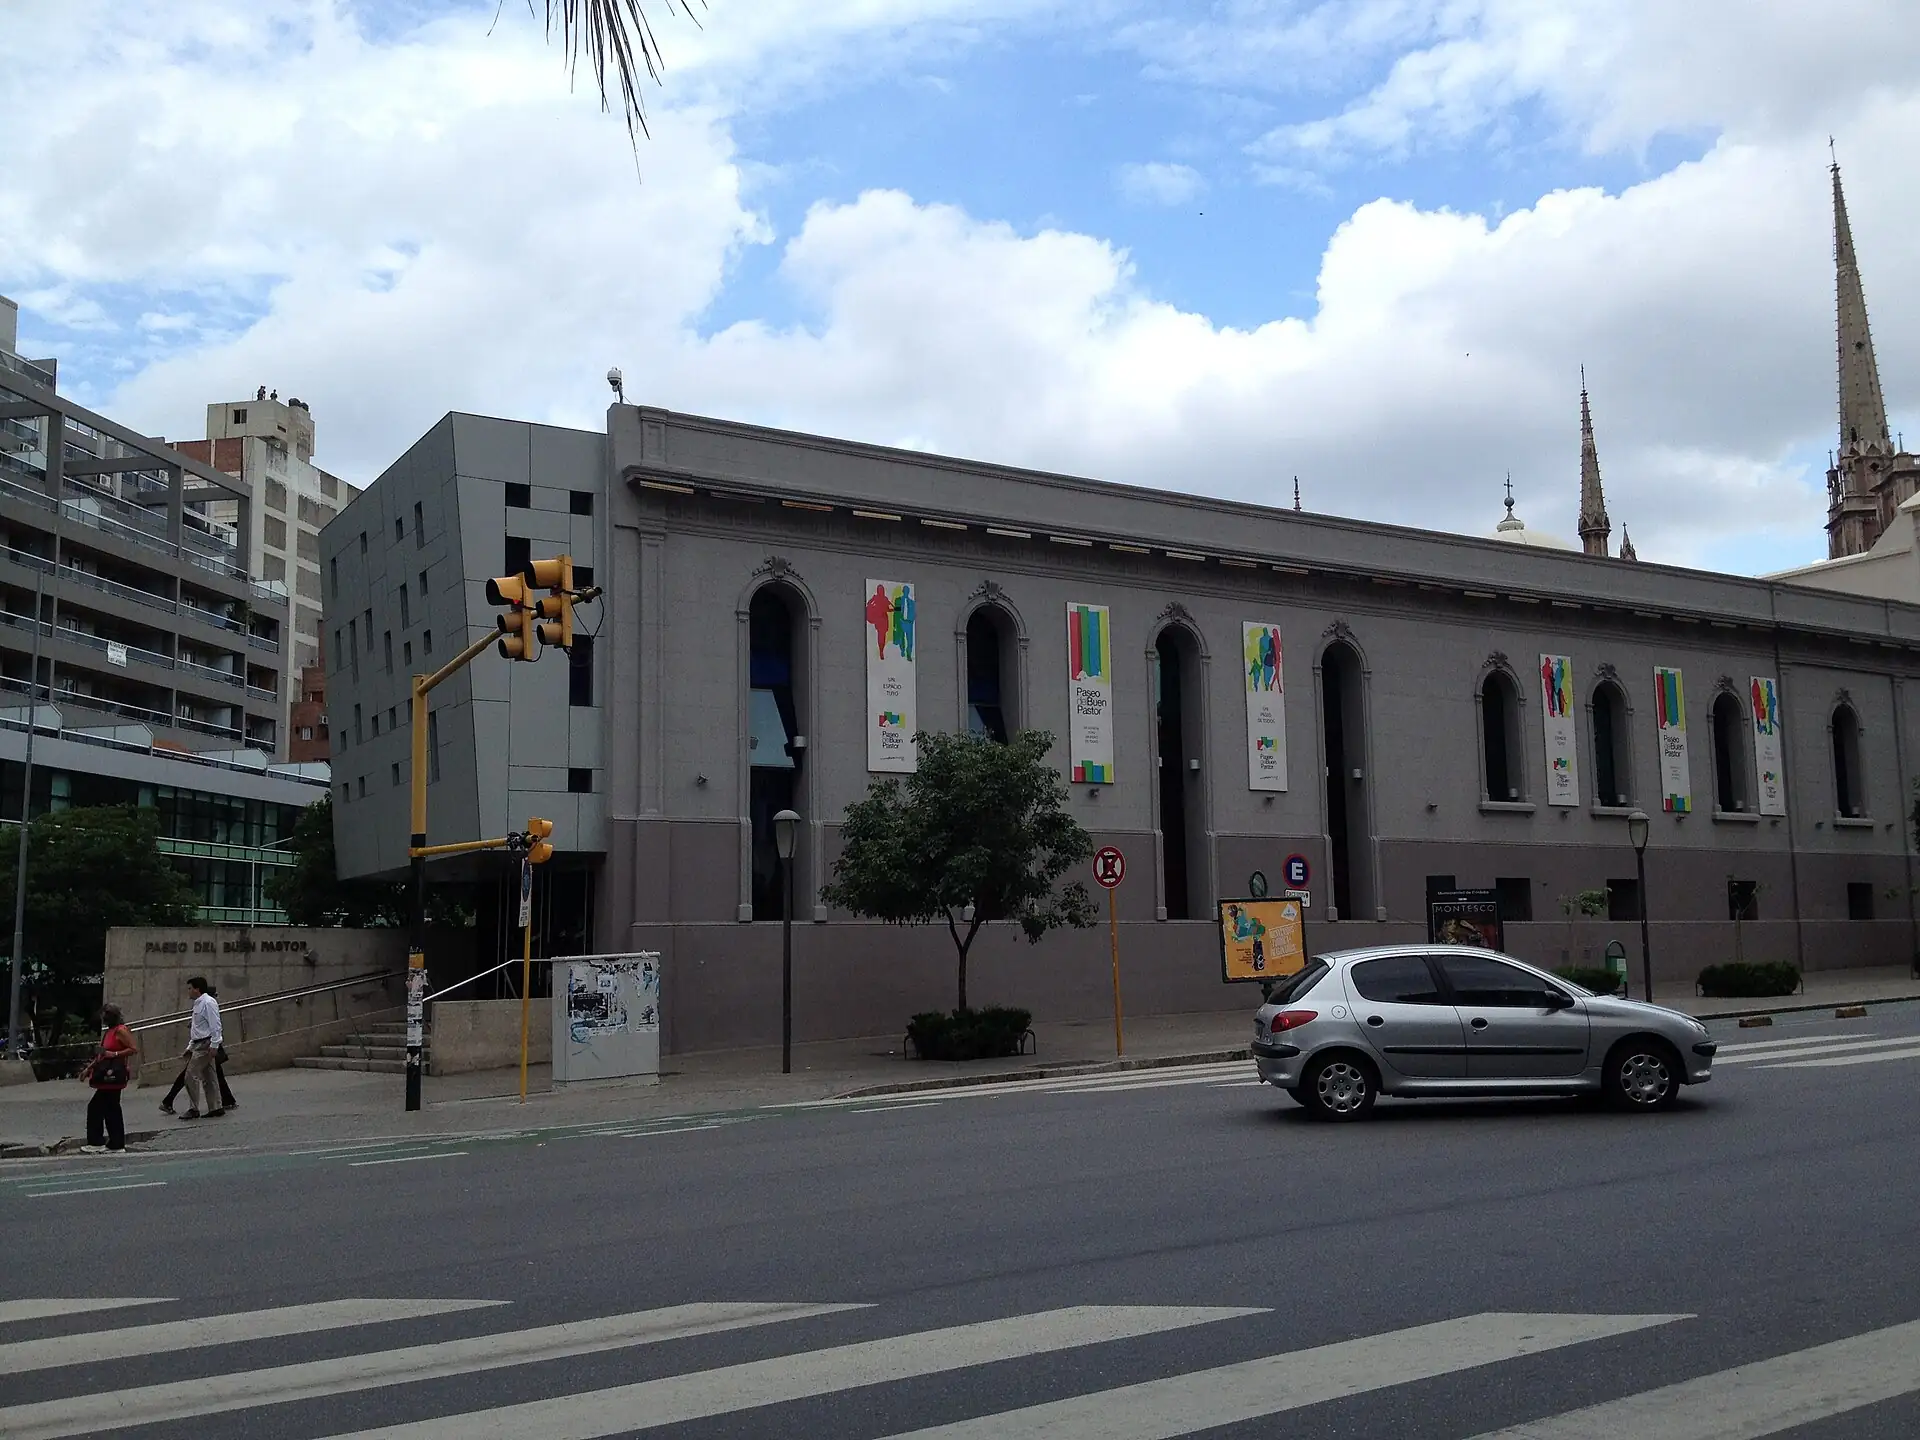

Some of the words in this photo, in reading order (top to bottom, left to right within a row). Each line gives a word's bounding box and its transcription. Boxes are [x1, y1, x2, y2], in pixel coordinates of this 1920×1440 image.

[1076, 687, 1101, 698] Paseo
[1077, 705, 1102, 715] Pastor
[1664, 735, 1680, 743] Paseo
[1664, 749, 1681, 757] Pastor
[1291, 862, 1304, 880] E
[1435, 904, 1495, 913] MONTESCO
[145, 941, 188, 953] PASEO
[193, 941, 216, 953] DEL
[223, 941, 256, 953] BUEN
[261, 941, 307, 953] PASTOR
